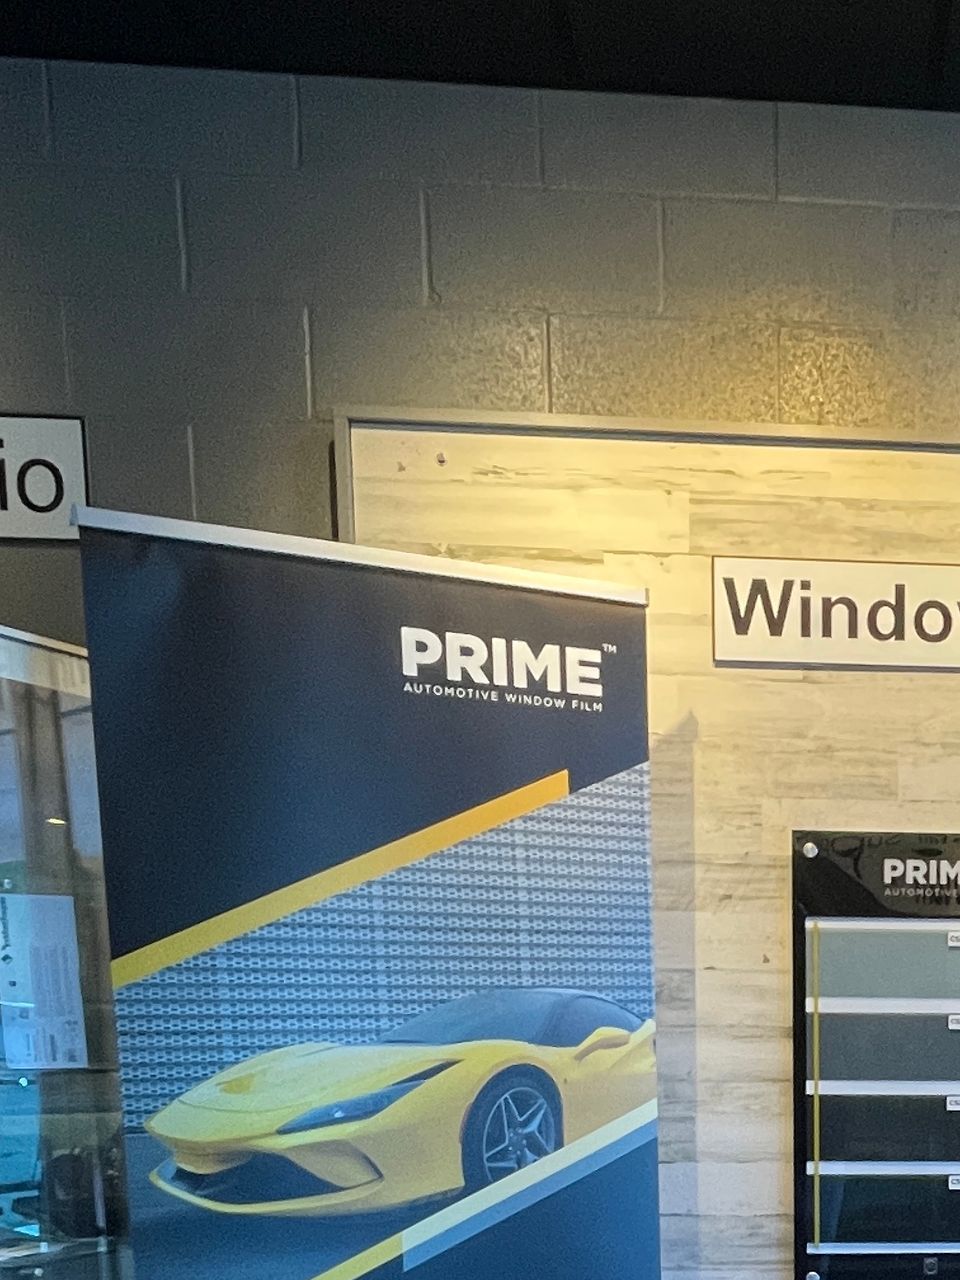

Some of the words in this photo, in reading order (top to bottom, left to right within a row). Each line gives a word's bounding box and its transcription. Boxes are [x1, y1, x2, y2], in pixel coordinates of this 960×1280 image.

[401, 626, 603, 697] PRIME
[403, 682, 499, 702] AUTOMOTIVE
[505, 693, 566, 709] WINDOW
[572, 700, 603, 713] FILM
[884, 887, 957, 898] AUTOMOTIVE
